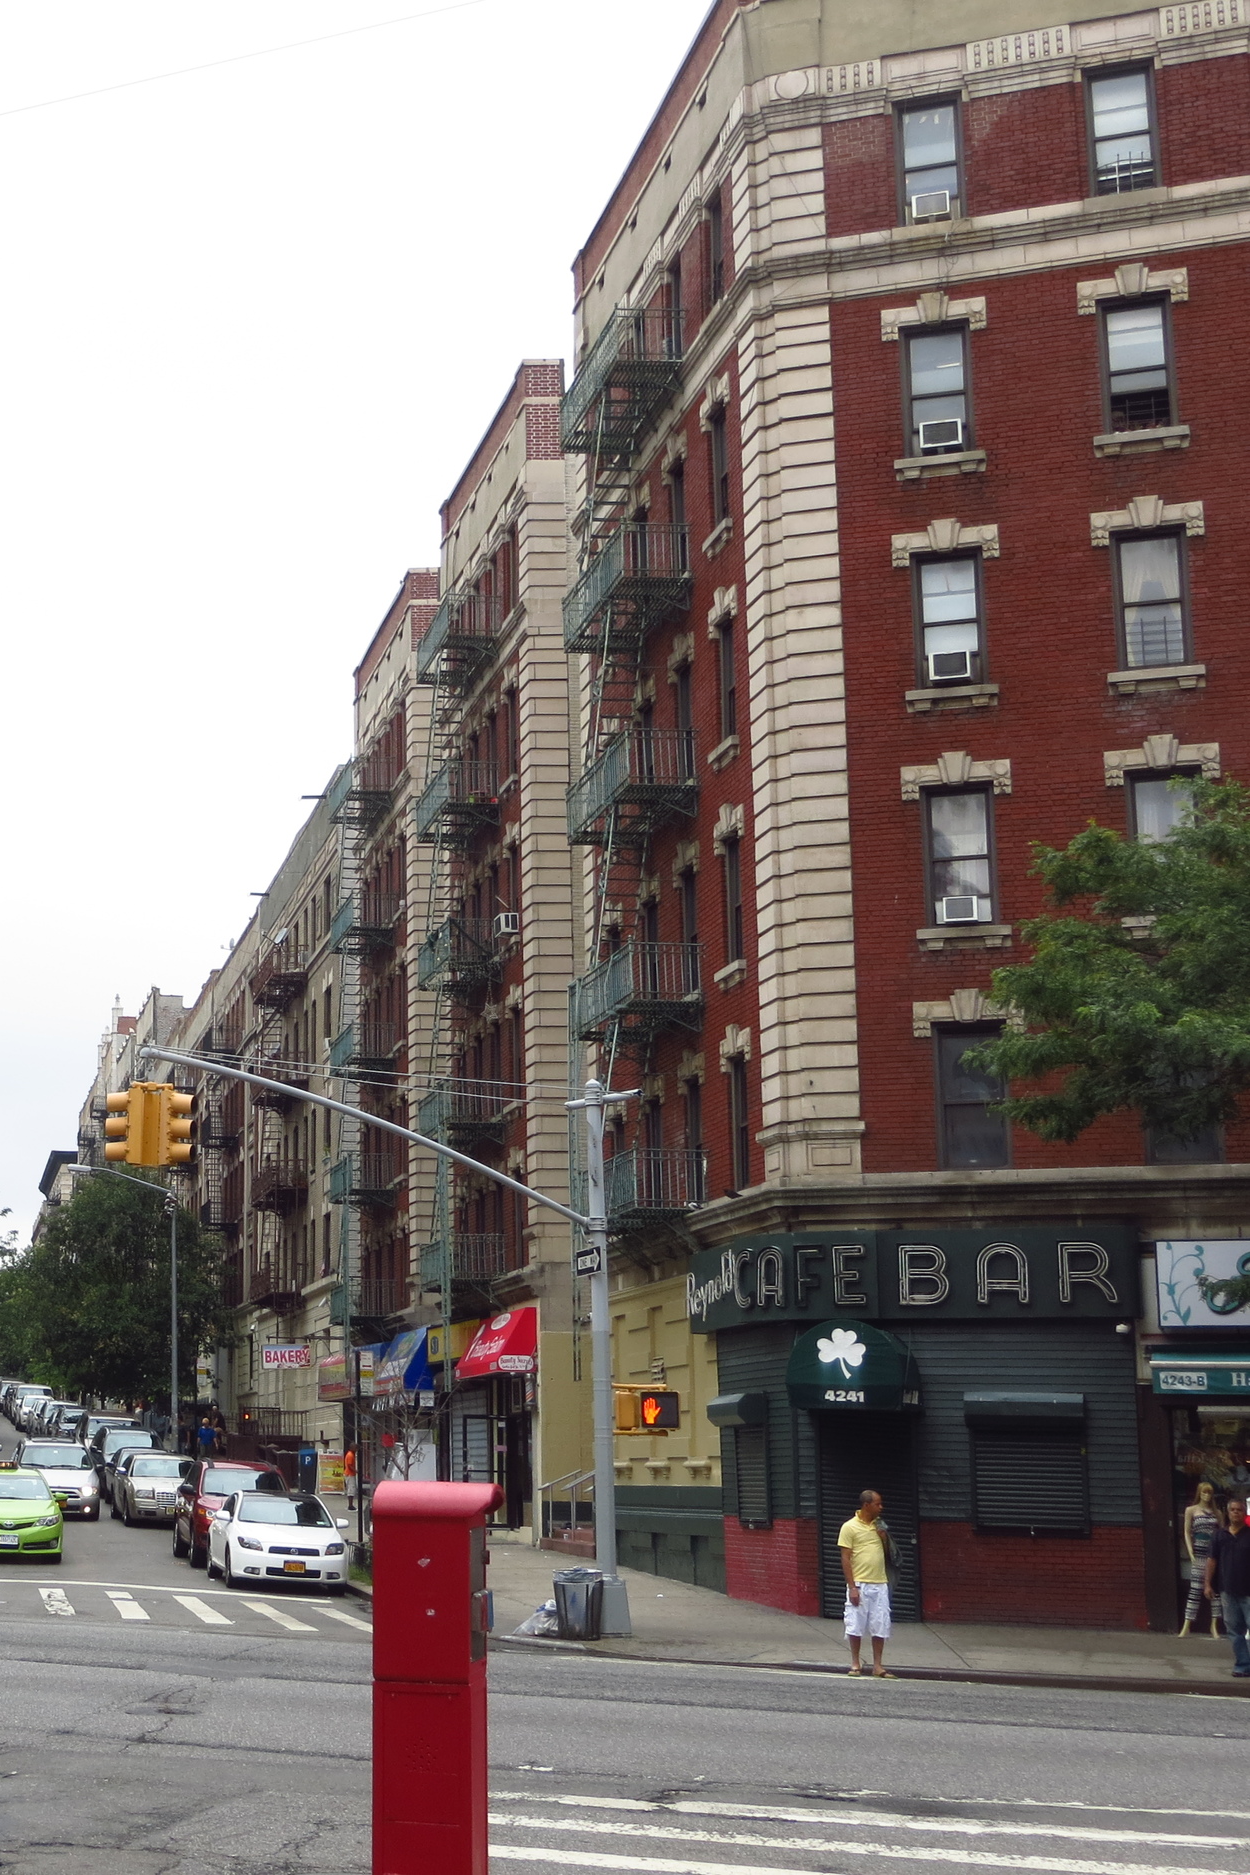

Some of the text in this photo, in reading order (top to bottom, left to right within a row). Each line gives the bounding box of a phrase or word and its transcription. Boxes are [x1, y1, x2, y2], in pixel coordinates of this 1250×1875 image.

[734, 1245, 867, 1309] CAFE
[899, 1242, 1118, 1305] BAR
[265, 1350, 308, 1363] BAKERY
[1162, 1374, 1205, 1388] 4243-B
[825, 1390, 864, 1402] 4241
[305, 1456, 311, 1464] P
